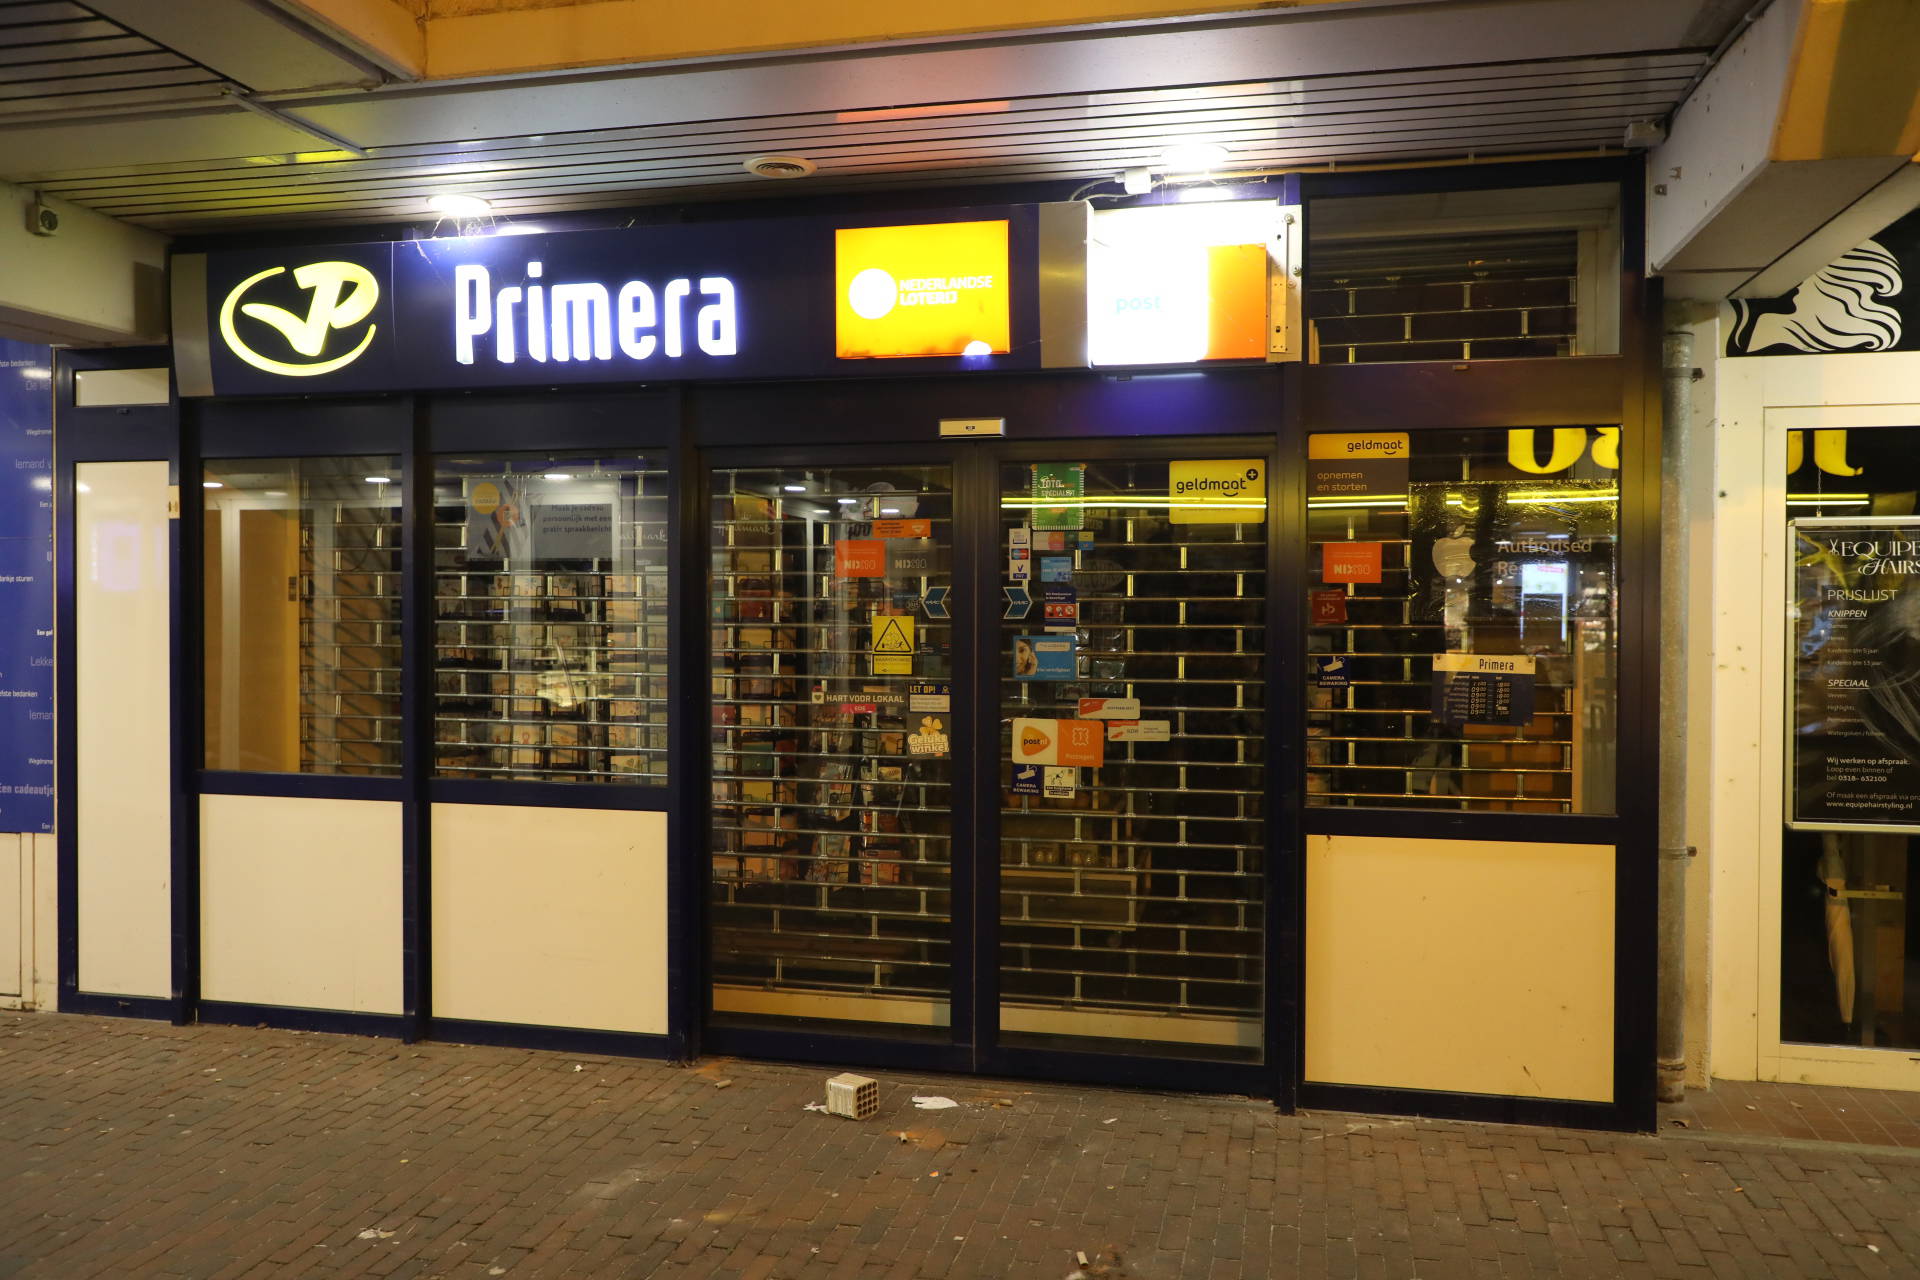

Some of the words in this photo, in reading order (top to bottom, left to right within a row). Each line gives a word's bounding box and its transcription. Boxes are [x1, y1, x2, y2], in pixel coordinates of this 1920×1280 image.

[899, 275, 993, 291] NEDERLANDSE
[899, 290, 958, 306] LOTERIJ
[455, 261, 737, 364] Primera
[1115, 295, 1162, 317] post
[1347, 440, 1405, 455] geldmaat
[1317, 472, 1364, 482] opnemen
[1176, 477, 1248, 496] geldmaat
[1331, 482, 1368, 491] storten
[1496, 538, 1592, 552] Authorised
[1827, 589, 1899, 602] PRIJSLIJST
[1828, 609, 1868, 618] KNIPPEN
[1479, 658, 1515, 671] Primera
[909, 685, 922, 694] LET
[1827, 679, 1870, 688] SPECIAAL
[826, 694, 848, 703] HART
[849, 694, 872, 703] VOOR
[872, 694, 905, 703] LOKAAL
[1023, 736, 1049, 746] postnl
[1840, 757, 1866, 765] werken
[1867, 758, 1877, 766] op
